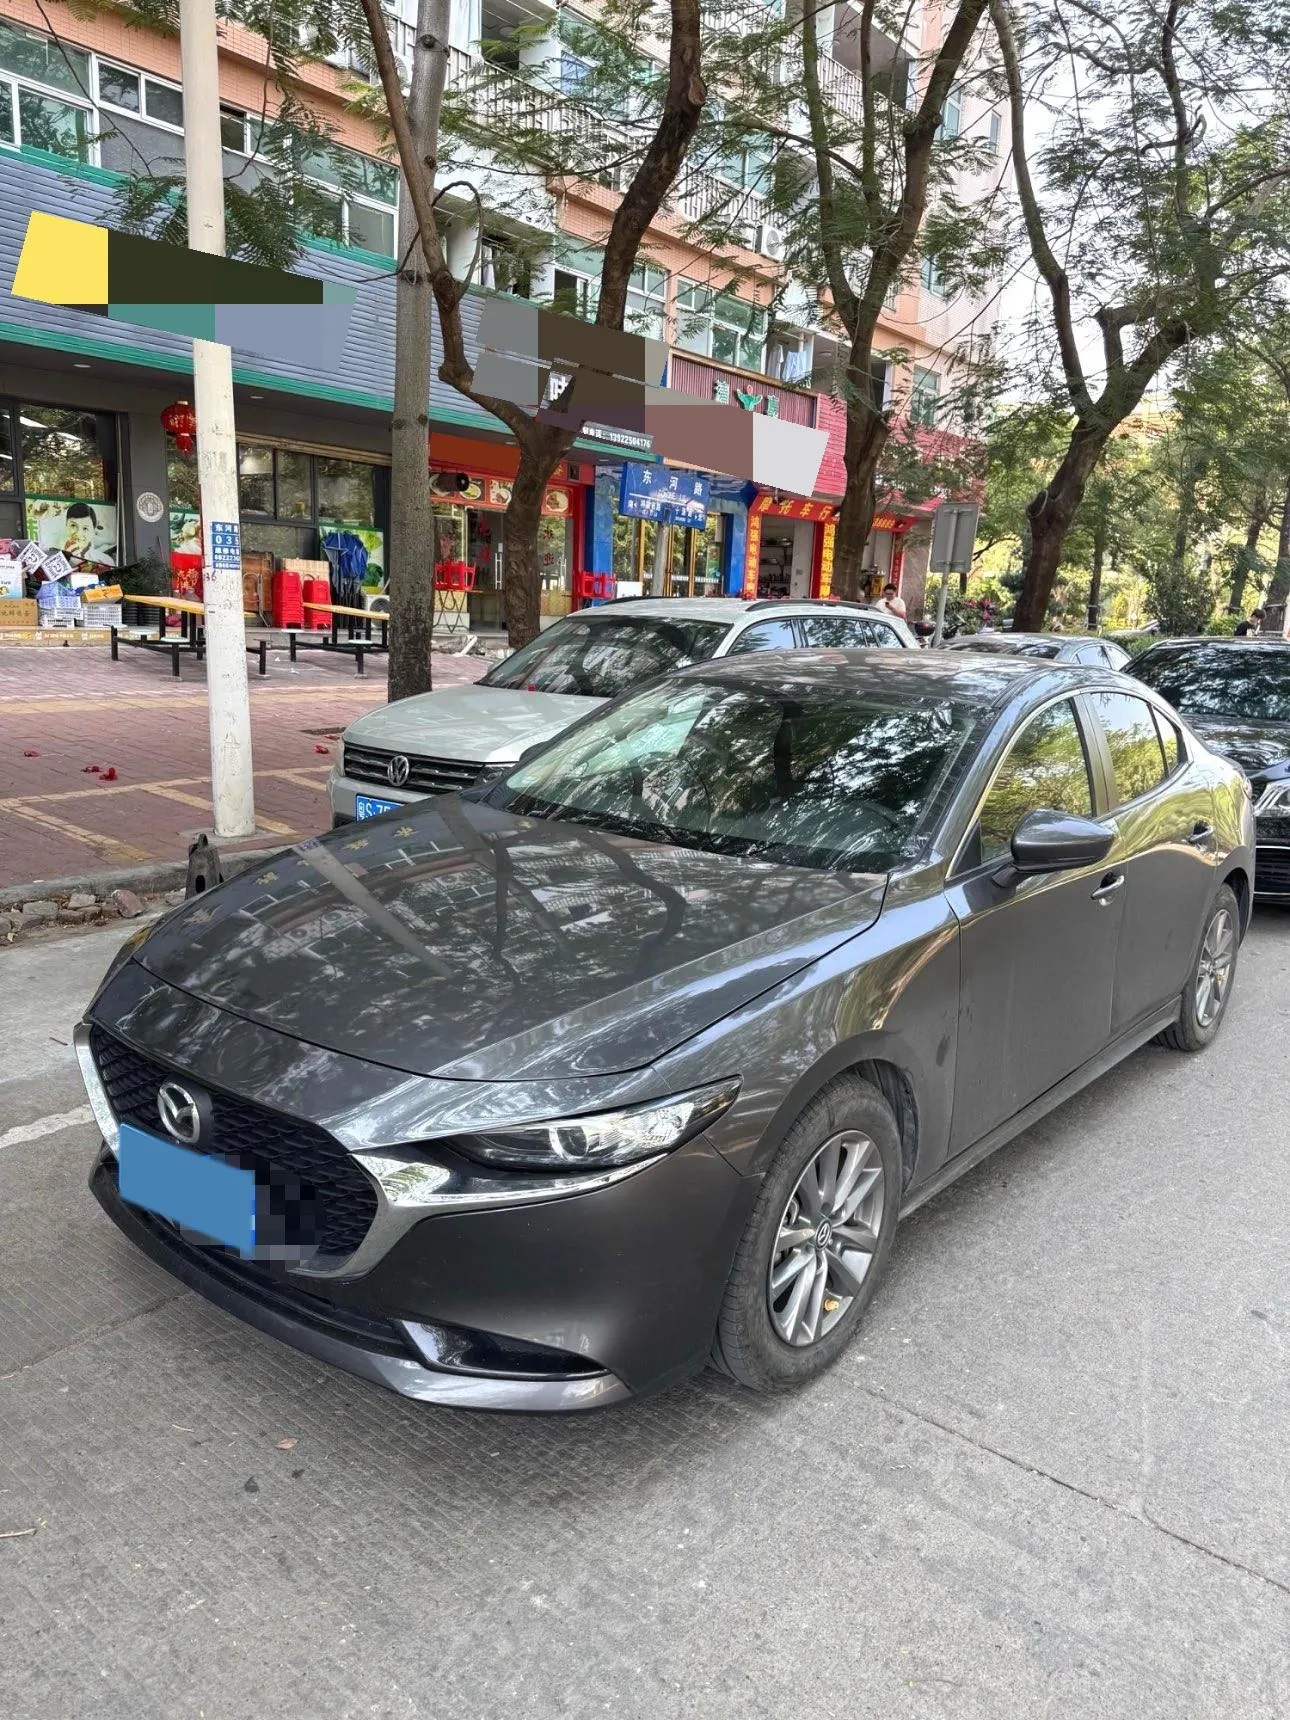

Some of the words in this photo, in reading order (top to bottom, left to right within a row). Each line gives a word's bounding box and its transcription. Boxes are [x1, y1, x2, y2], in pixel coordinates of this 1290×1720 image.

[642, 469, 704, 497] 东河路
[758, 496, 833, 521] 摩托车行
